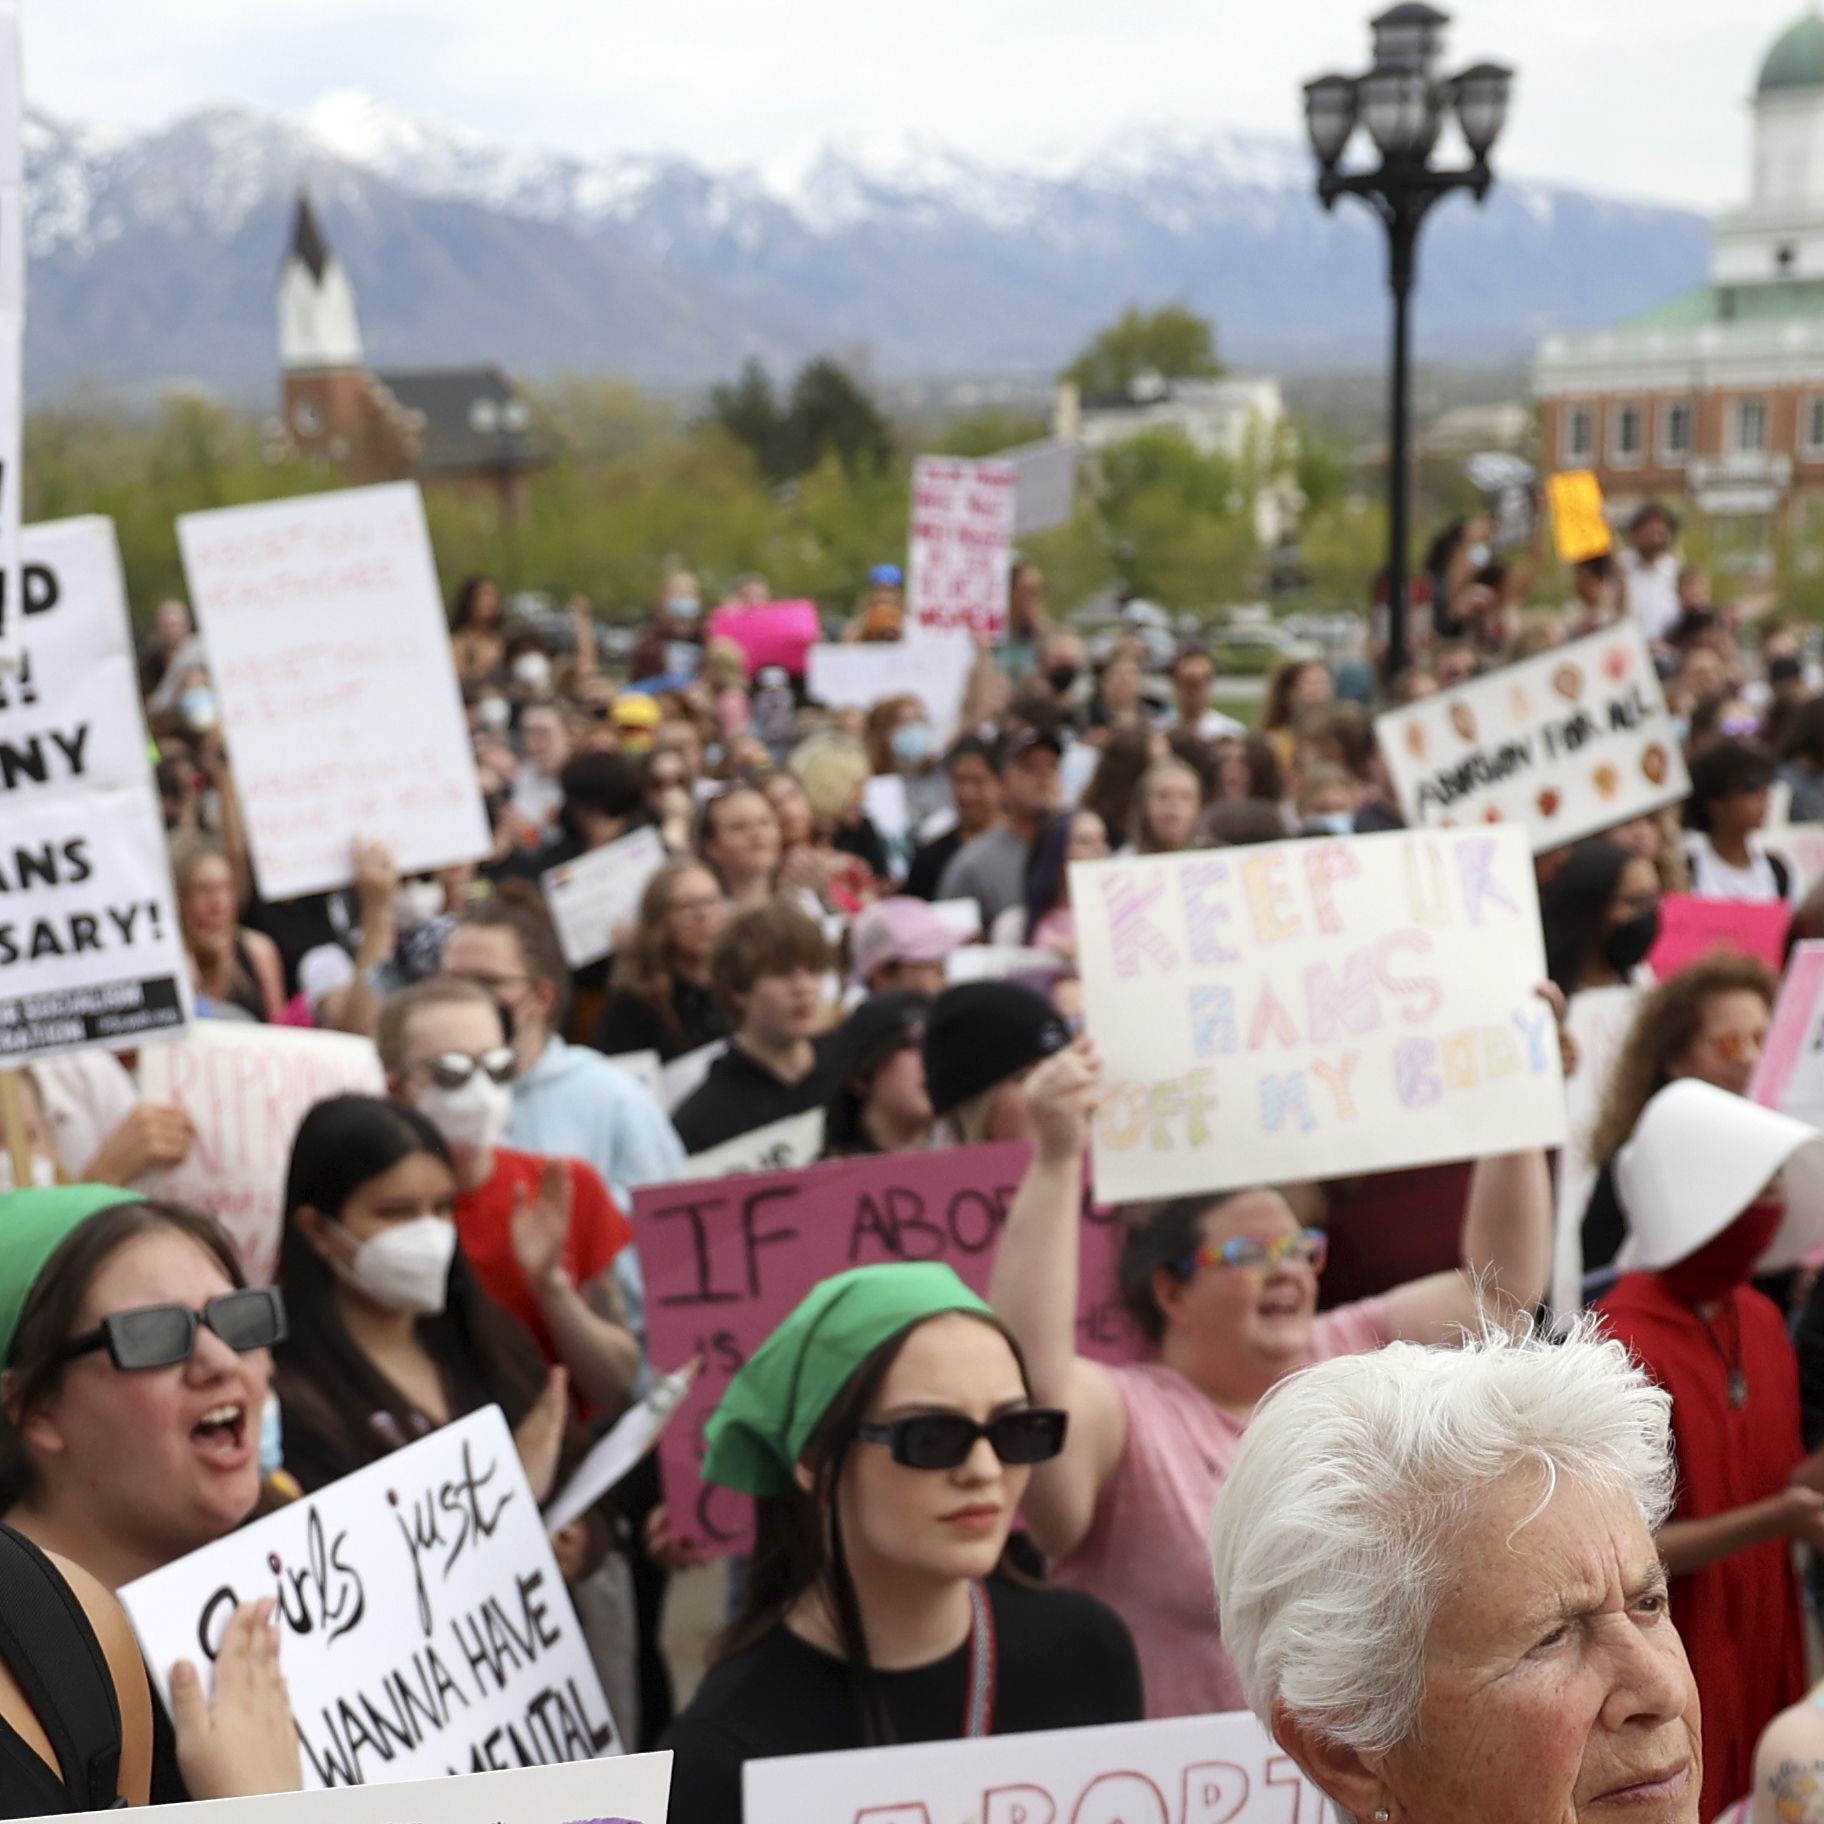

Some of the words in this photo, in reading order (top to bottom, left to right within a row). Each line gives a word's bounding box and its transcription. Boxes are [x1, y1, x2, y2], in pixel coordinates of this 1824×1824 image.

[1101, 839, 1361, 977] KEEP
[1097, 1066, 1217, 1151] OFF
[1260, 1048, 1363, 1133] MY
[1393, 1008, 1549, 1110] BODY
[652, 1185, 803, 1308] IF
[451, 1567, 561, 1697] HAVE
[448, 1678, 613, 1777] ENTAL
